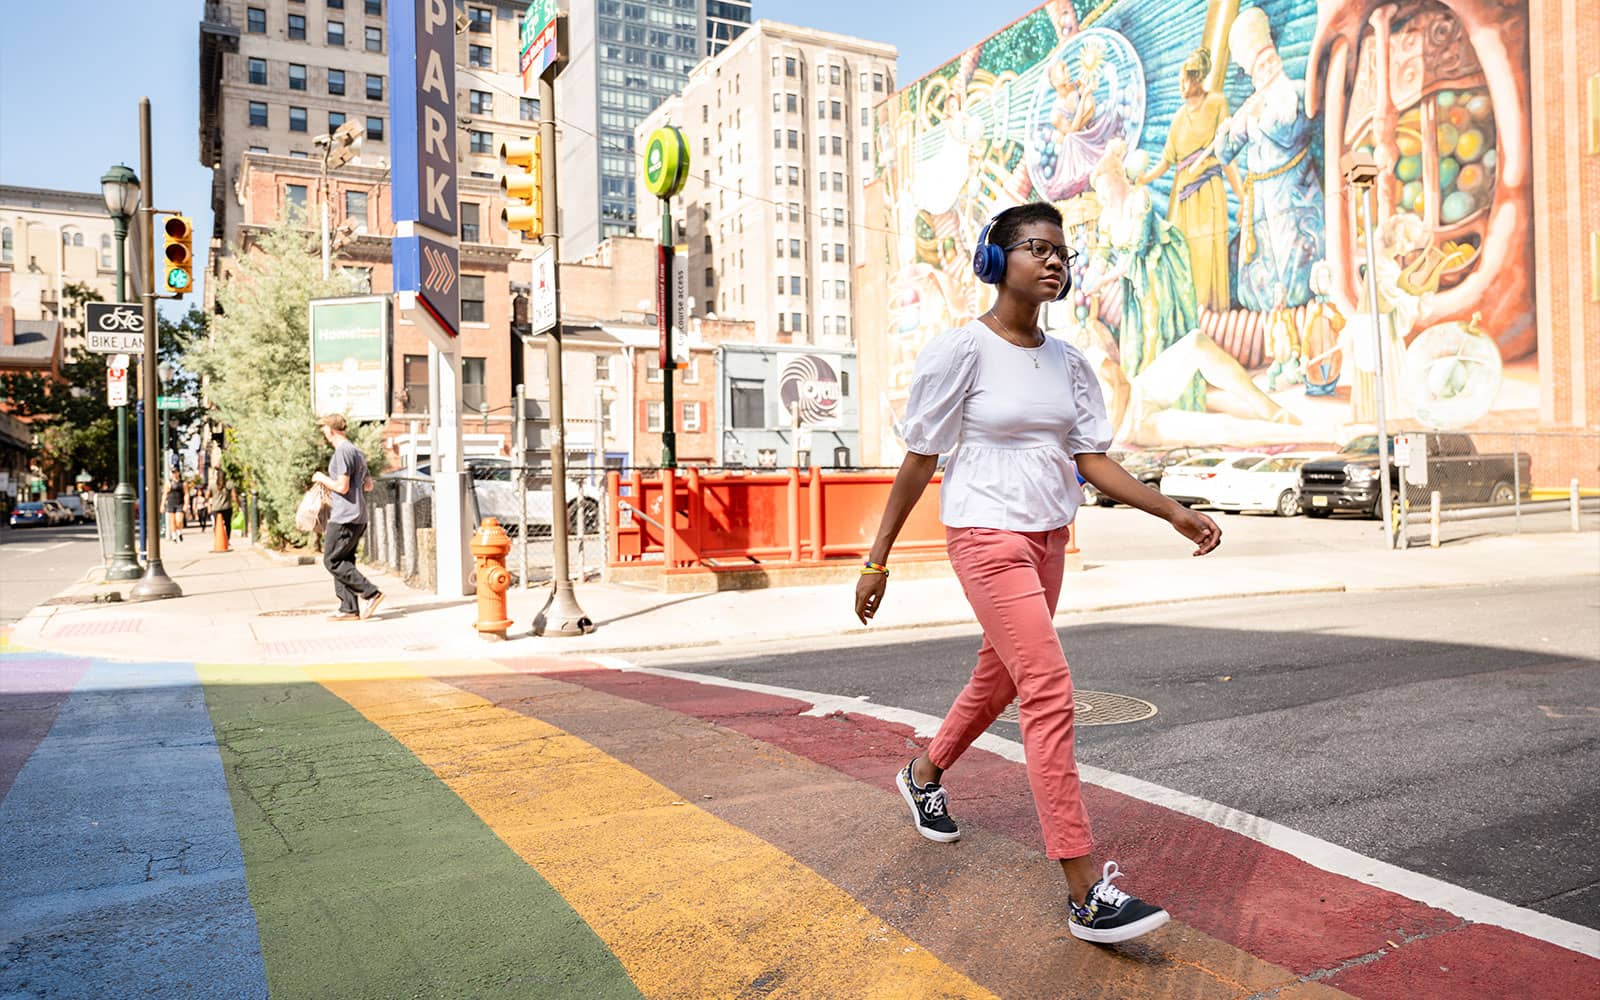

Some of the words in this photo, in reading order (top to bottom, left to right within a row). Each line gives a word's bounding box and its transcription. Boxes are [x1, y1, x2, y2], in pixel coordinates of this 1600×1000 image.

[422, 0, 451, 221] PARK
[91, 335, 118, 348] BIKE
[123, 337, 145, 349] LAN
